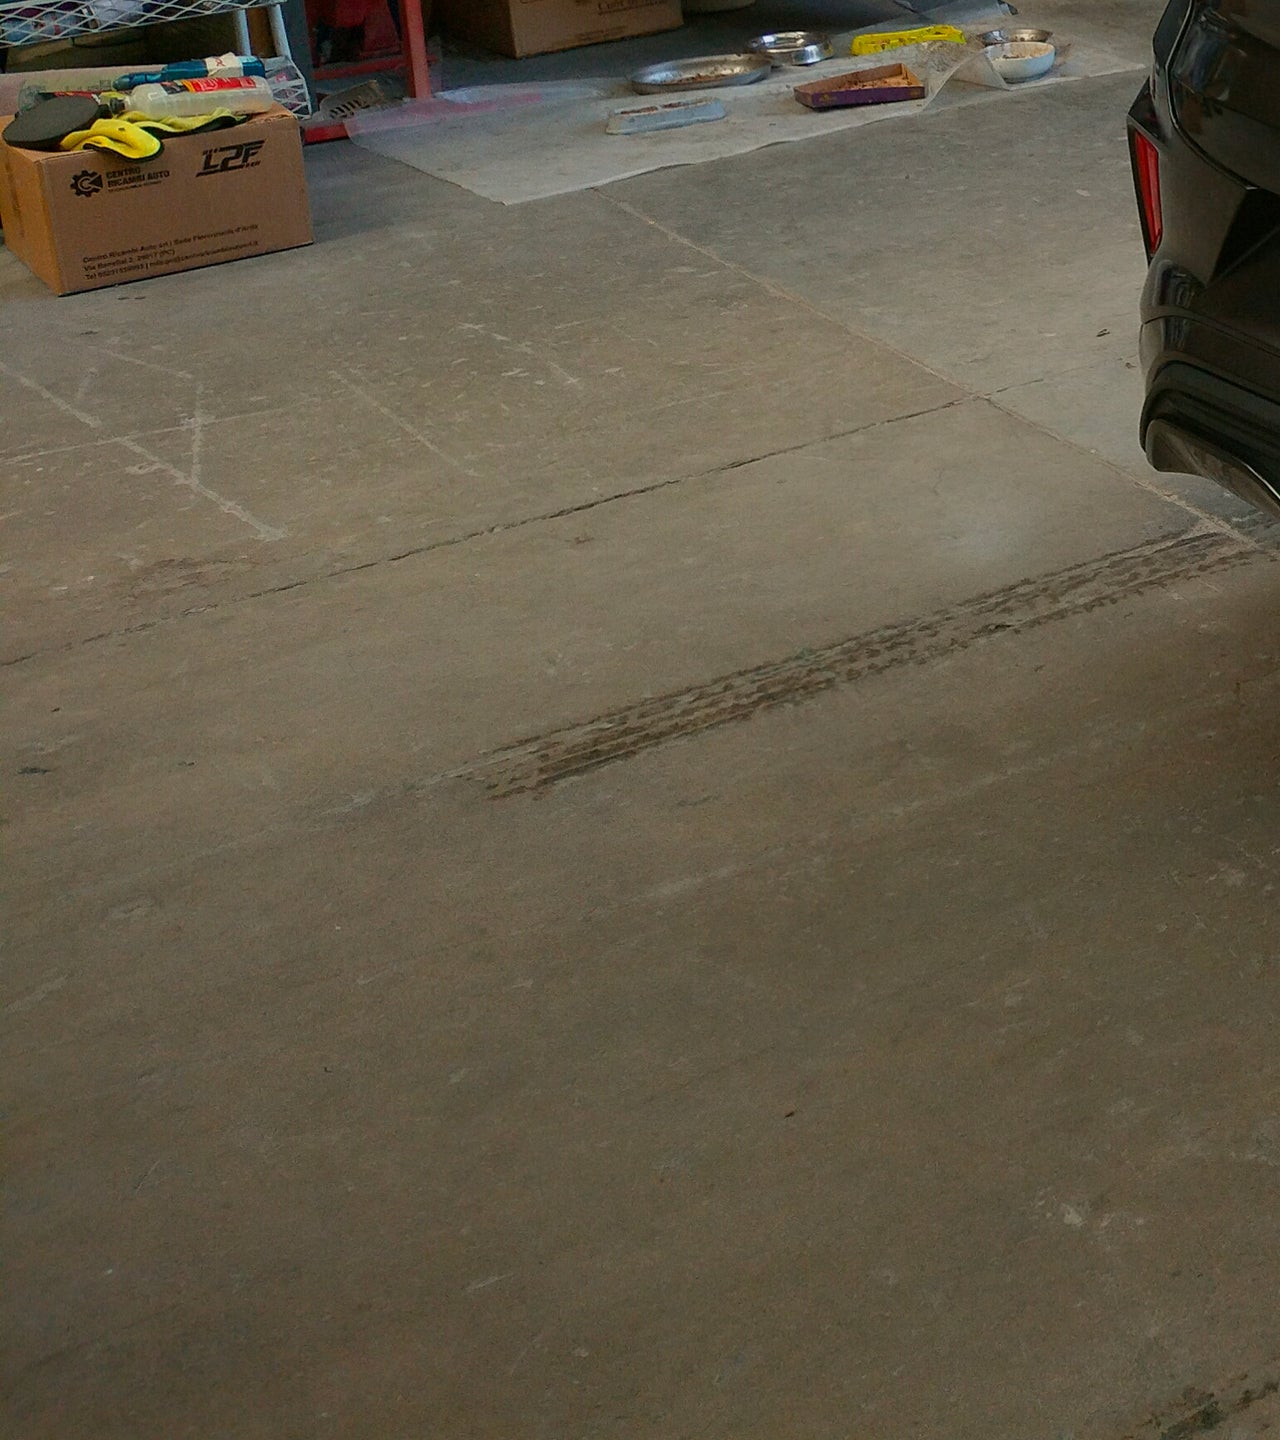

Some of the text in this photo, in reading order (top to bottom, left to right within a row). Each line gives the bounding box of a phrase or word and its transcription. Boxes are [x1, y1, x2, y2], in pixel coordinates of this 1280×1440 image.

[106, 166, 141, 179] CENTRO
[108, 174, 145, 188] RICAMBI
[147, 170, 170, 181] AUTO
